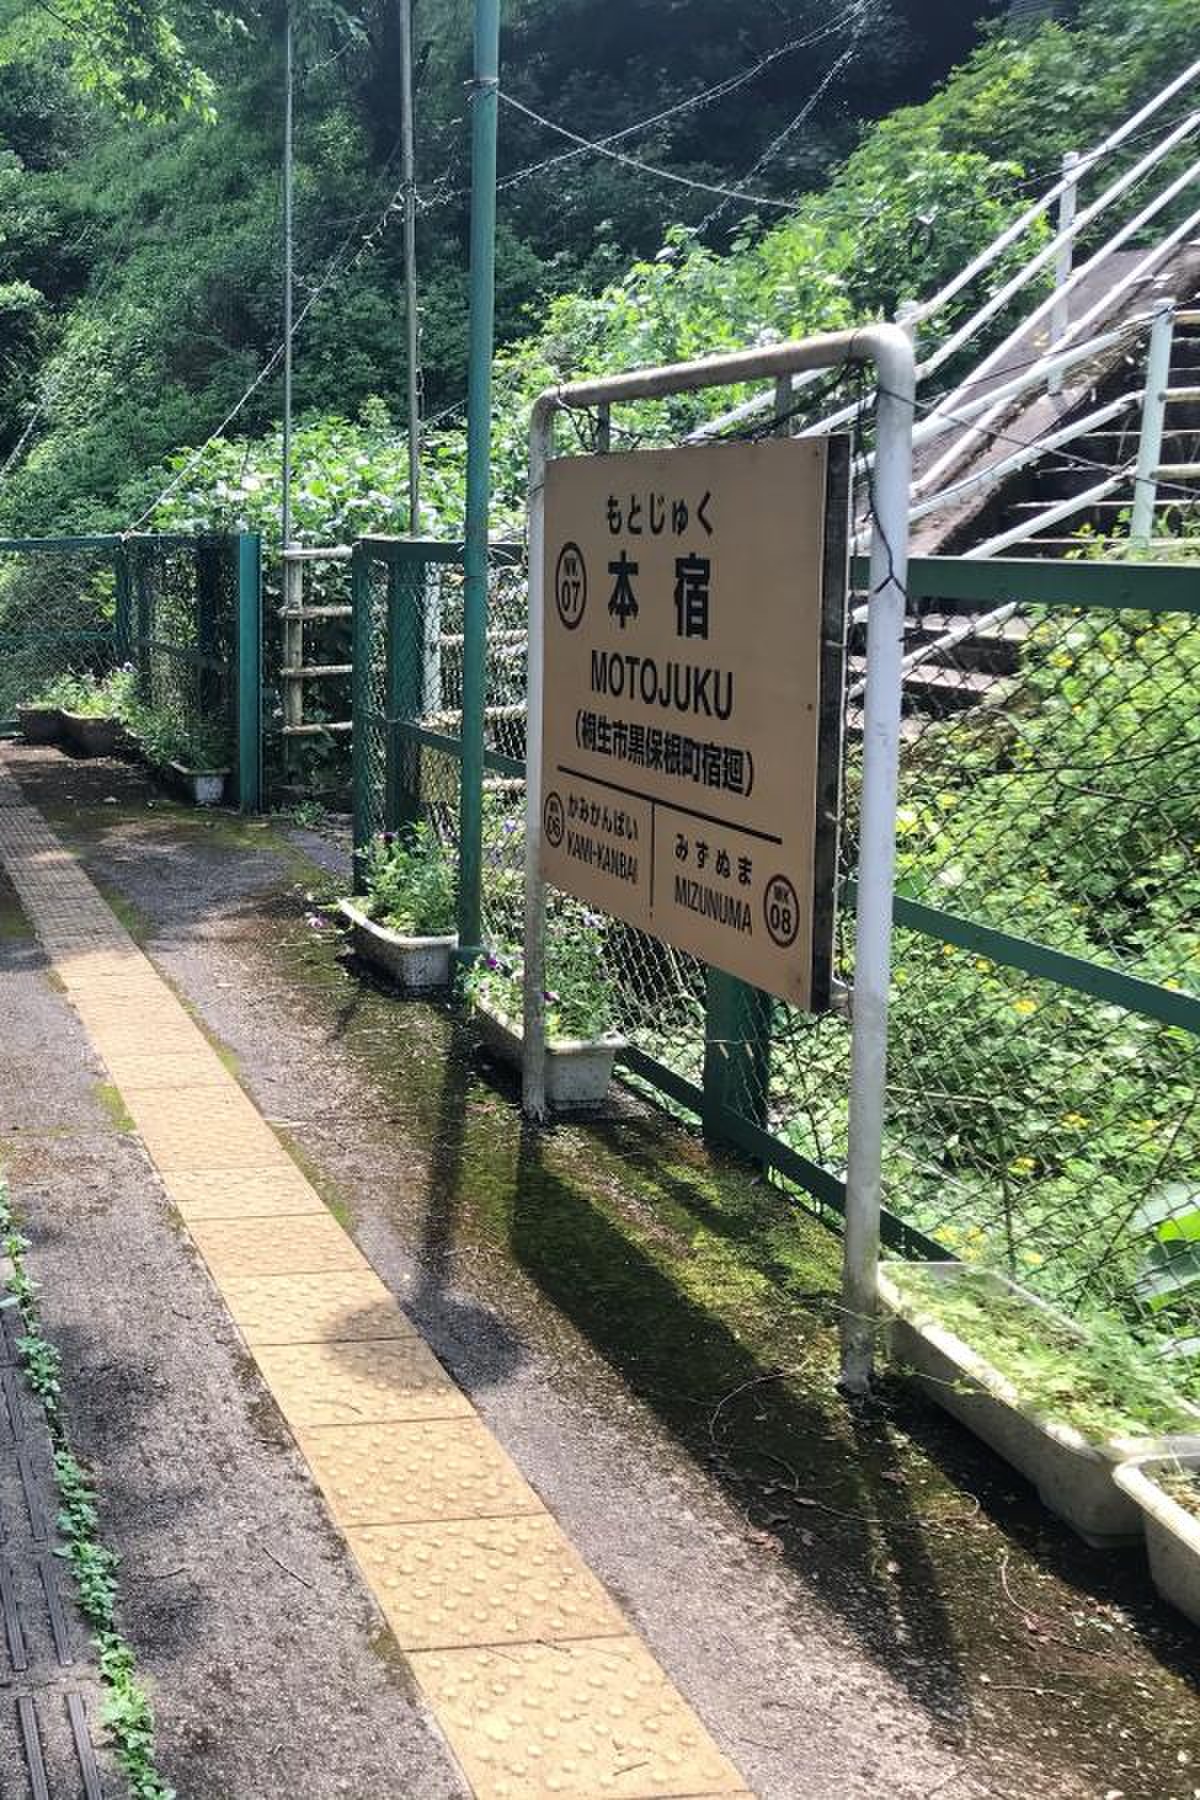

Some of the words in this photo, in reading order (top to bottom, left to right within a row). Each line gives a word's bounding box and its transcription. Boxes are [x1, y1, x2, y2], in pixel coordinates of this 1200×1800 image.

[606, 489, 713, 536] もとじゅく
[561, 580, 581, 613] 07
[607, 550, 711, 640] 本宿
[591, 649, 733, 721] MOTOJUKU
[675, 875, 752, 936] MIZUNUMA
[770, 903, 791, 934] 08
